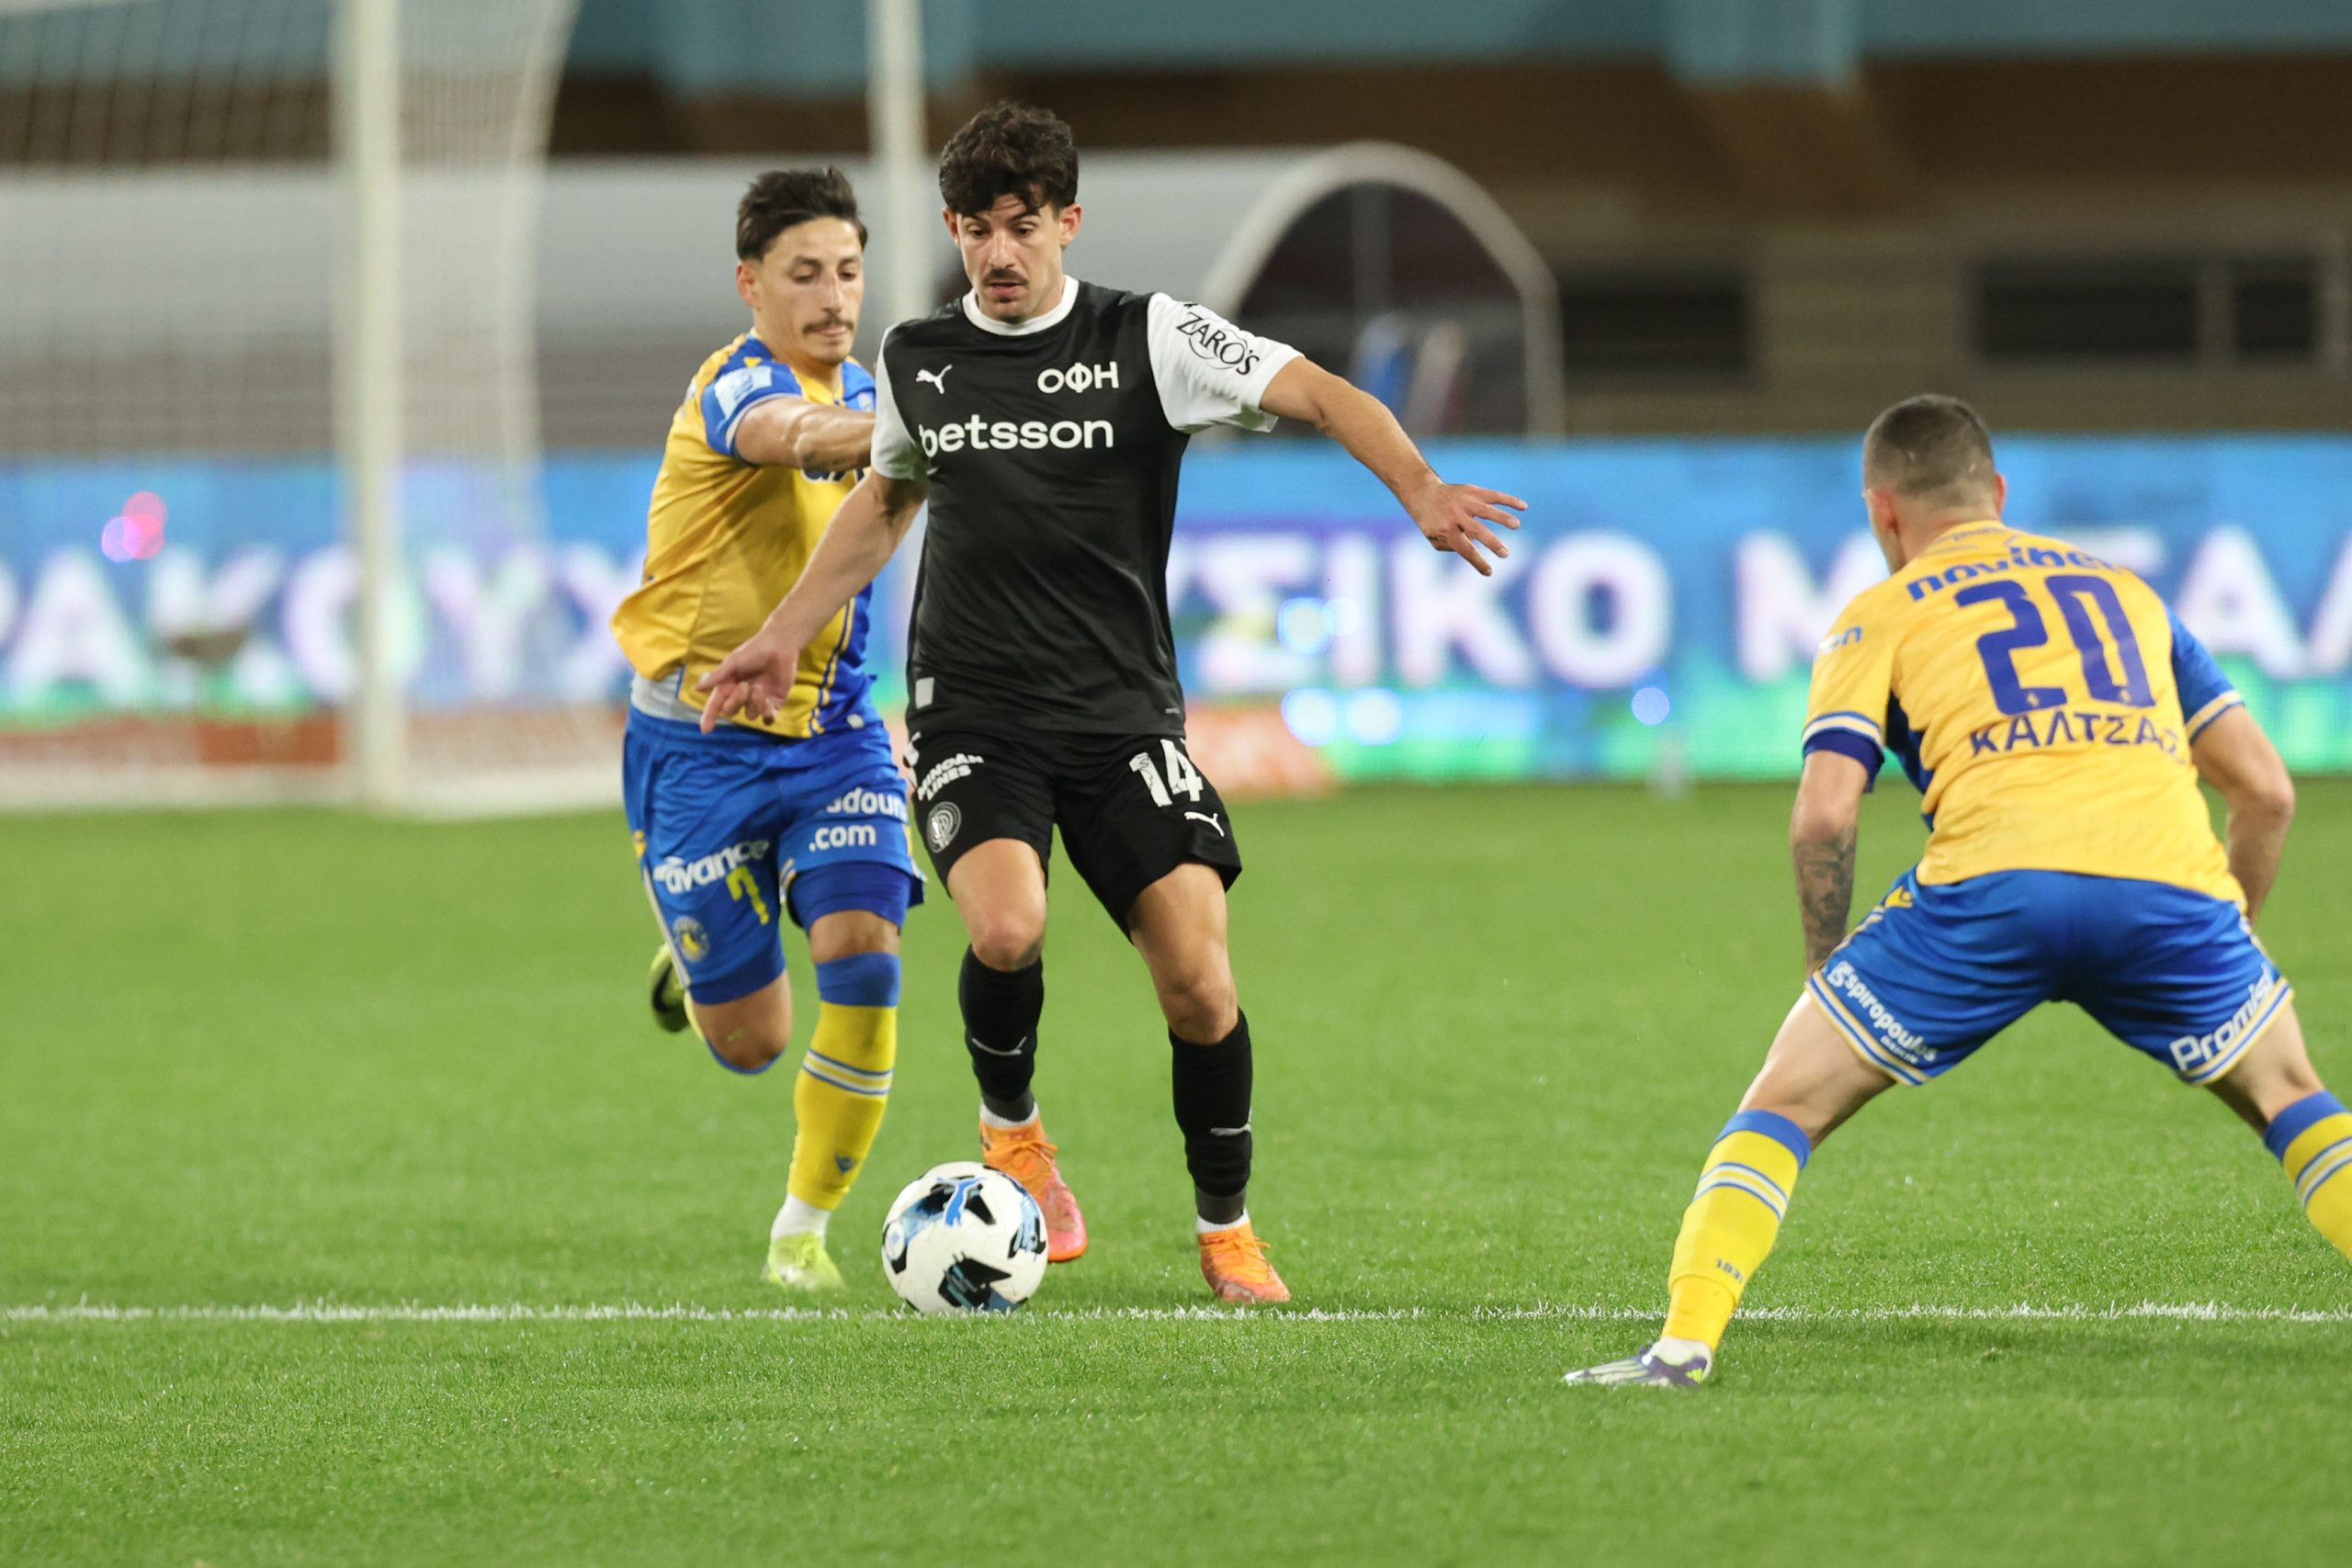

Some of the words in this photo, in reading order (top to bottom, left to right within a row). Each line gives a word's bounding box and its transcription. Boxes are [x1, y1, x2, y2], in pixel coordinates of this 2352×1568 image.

[1176, 311, 1260, 376] ZARO'S
[1037, 361, 1119, 393] ΟΦΗ
[919, 413, 1114, 457] betsson
[1953, 573, 2156, 716] 20
[1129, 739, 1204, 807] 14
[808, 825, 876, 852] .com
[725, 865, 770, 925] 7
